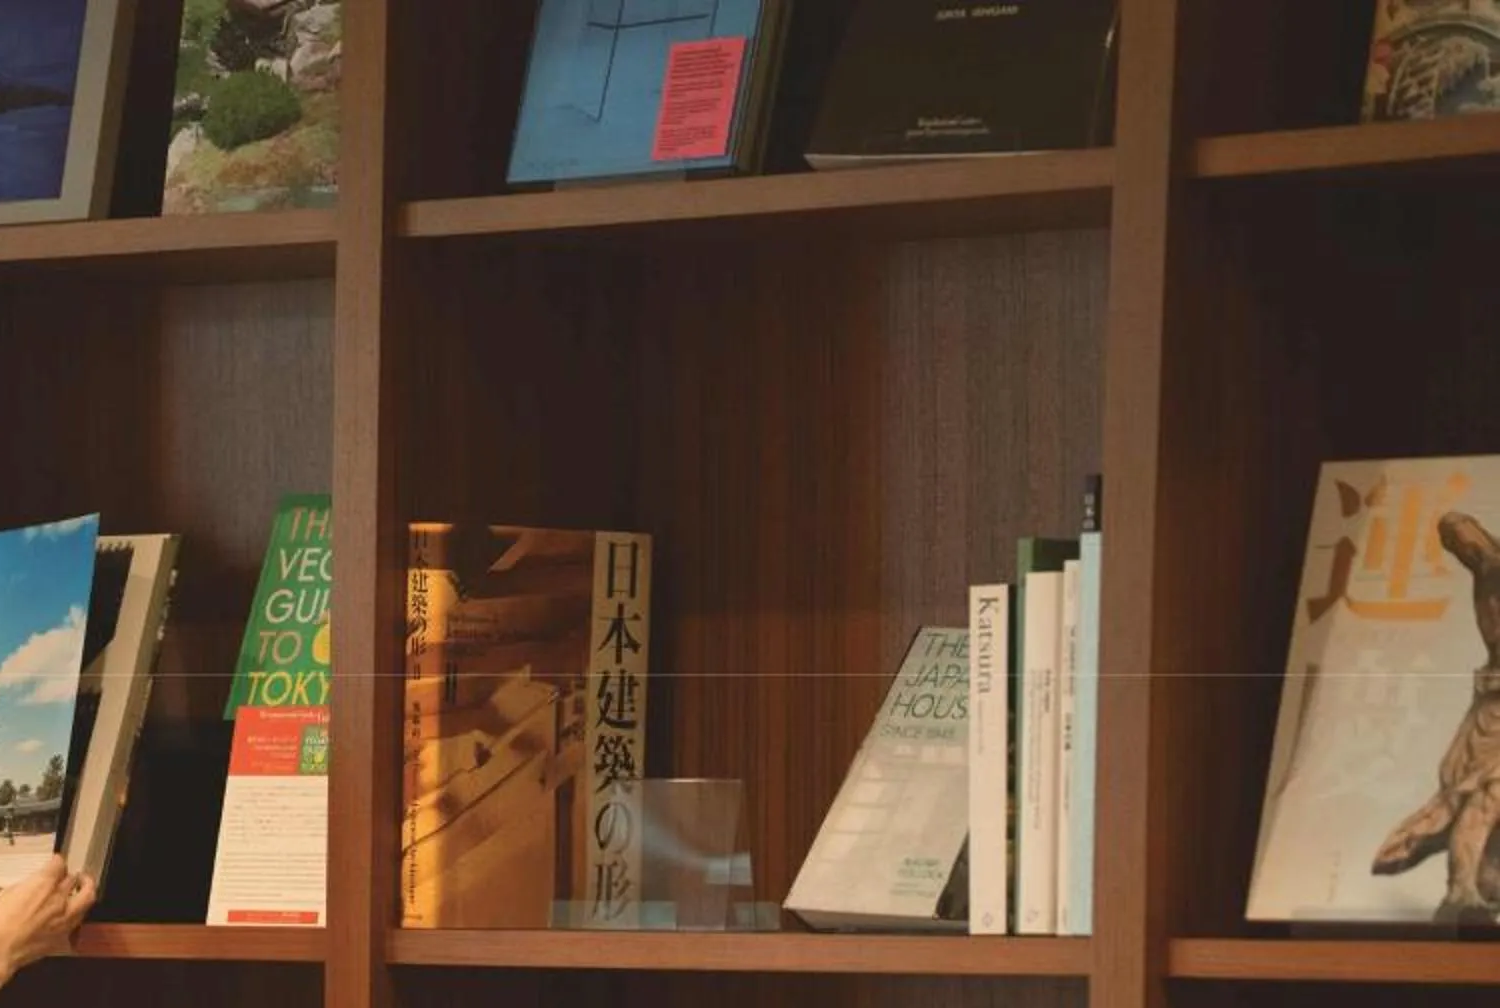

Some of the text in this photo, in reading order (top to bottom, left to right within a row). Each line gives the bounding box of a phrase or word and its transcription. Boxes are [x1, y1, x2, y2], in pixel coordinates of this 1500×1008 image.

[288, 507, 331, 542] TH
[257, 631, 301, 665] TO
[924, 632, 970, 659] THE
[978, 597, 999, 694] Katsura
[594, 541, 641, 921] 日本建築の形
